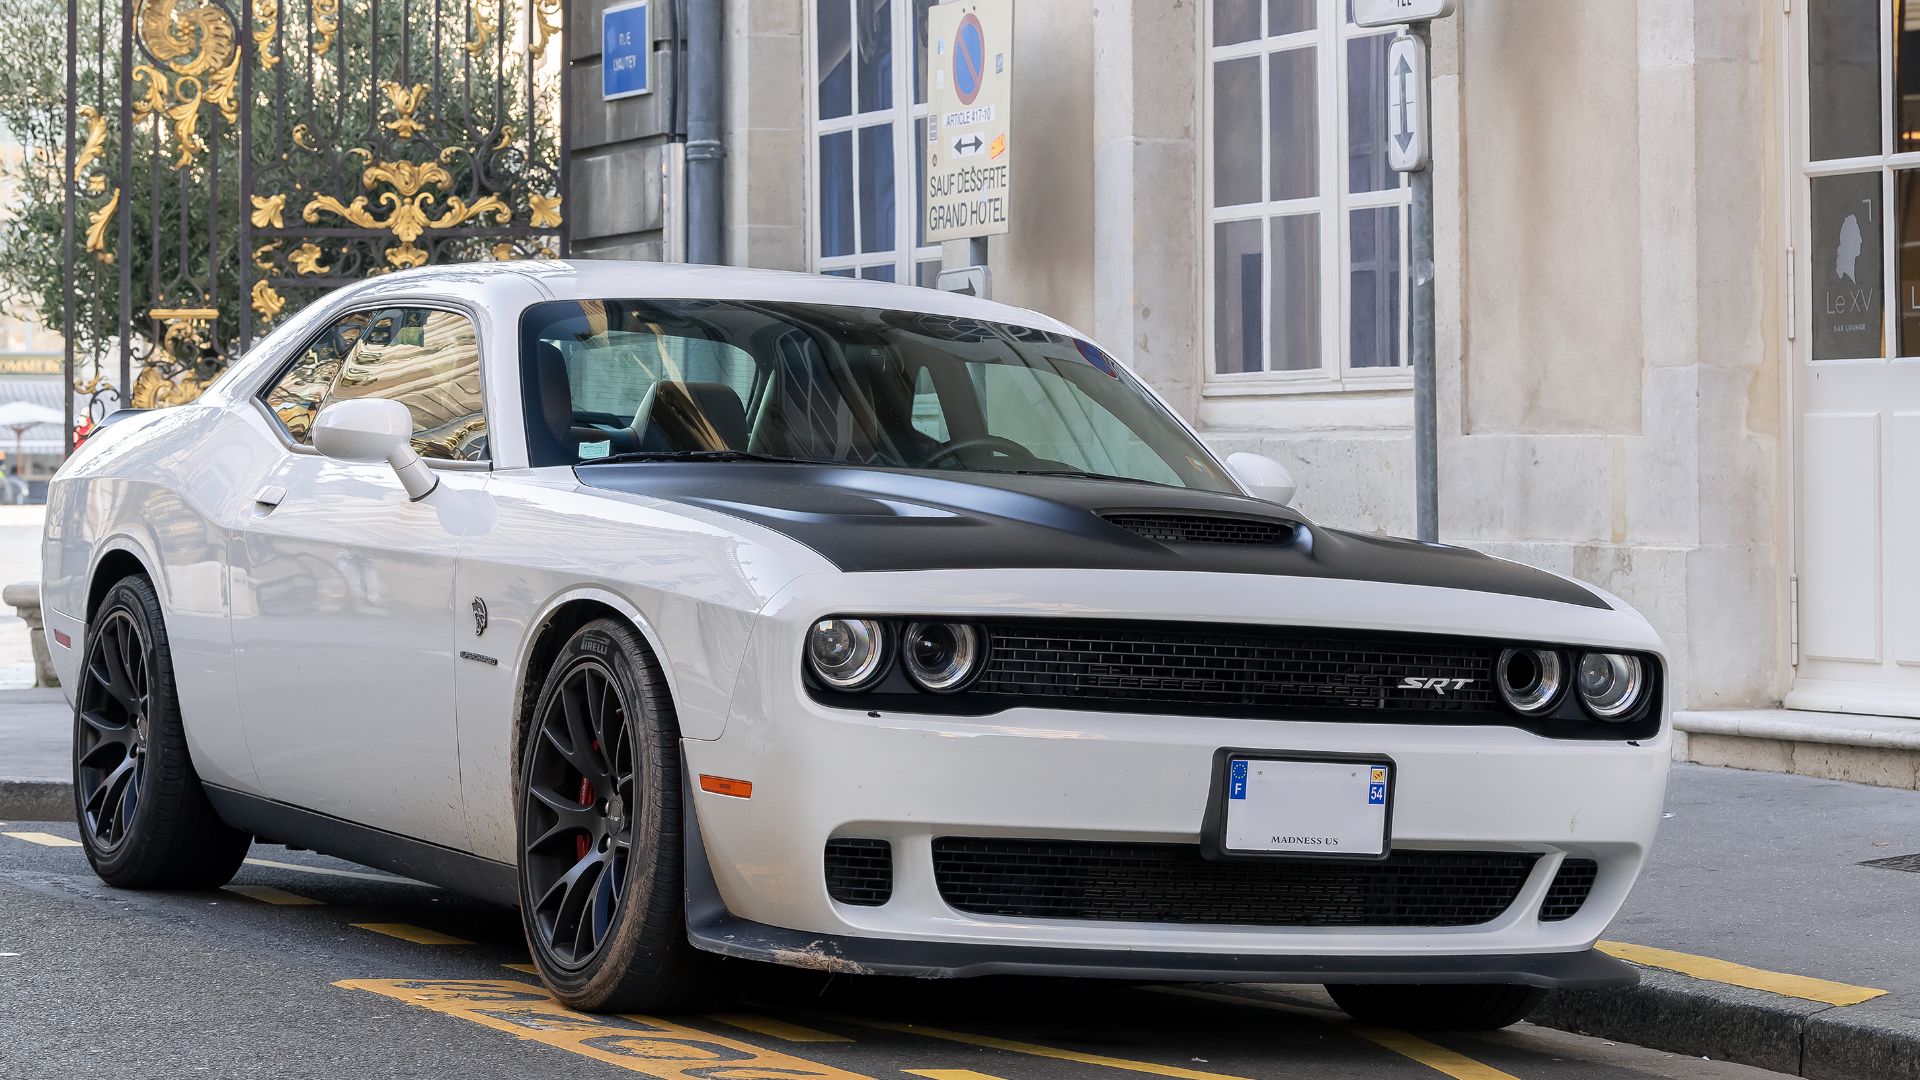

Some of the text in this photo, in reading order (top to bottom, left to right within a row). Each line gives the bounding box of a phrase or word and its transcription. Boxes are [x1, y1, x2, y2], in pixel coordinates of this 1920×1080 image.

[945, 107, 992, 128] ARTICLE 417-10
[930, 173, 955, 198] SAUF
[929, 202, 968, 231] GRAND
[1827, 288, 1873, 314] Le XV
[580, 633, 611, 656] PIRELLI
[1397, 677, 1474, 695] SRT
[1234, 782, 1242, 795] F
[1370, 786, 1383, 800] 54
[1270, 835, 1339, 845] MADNESS US
